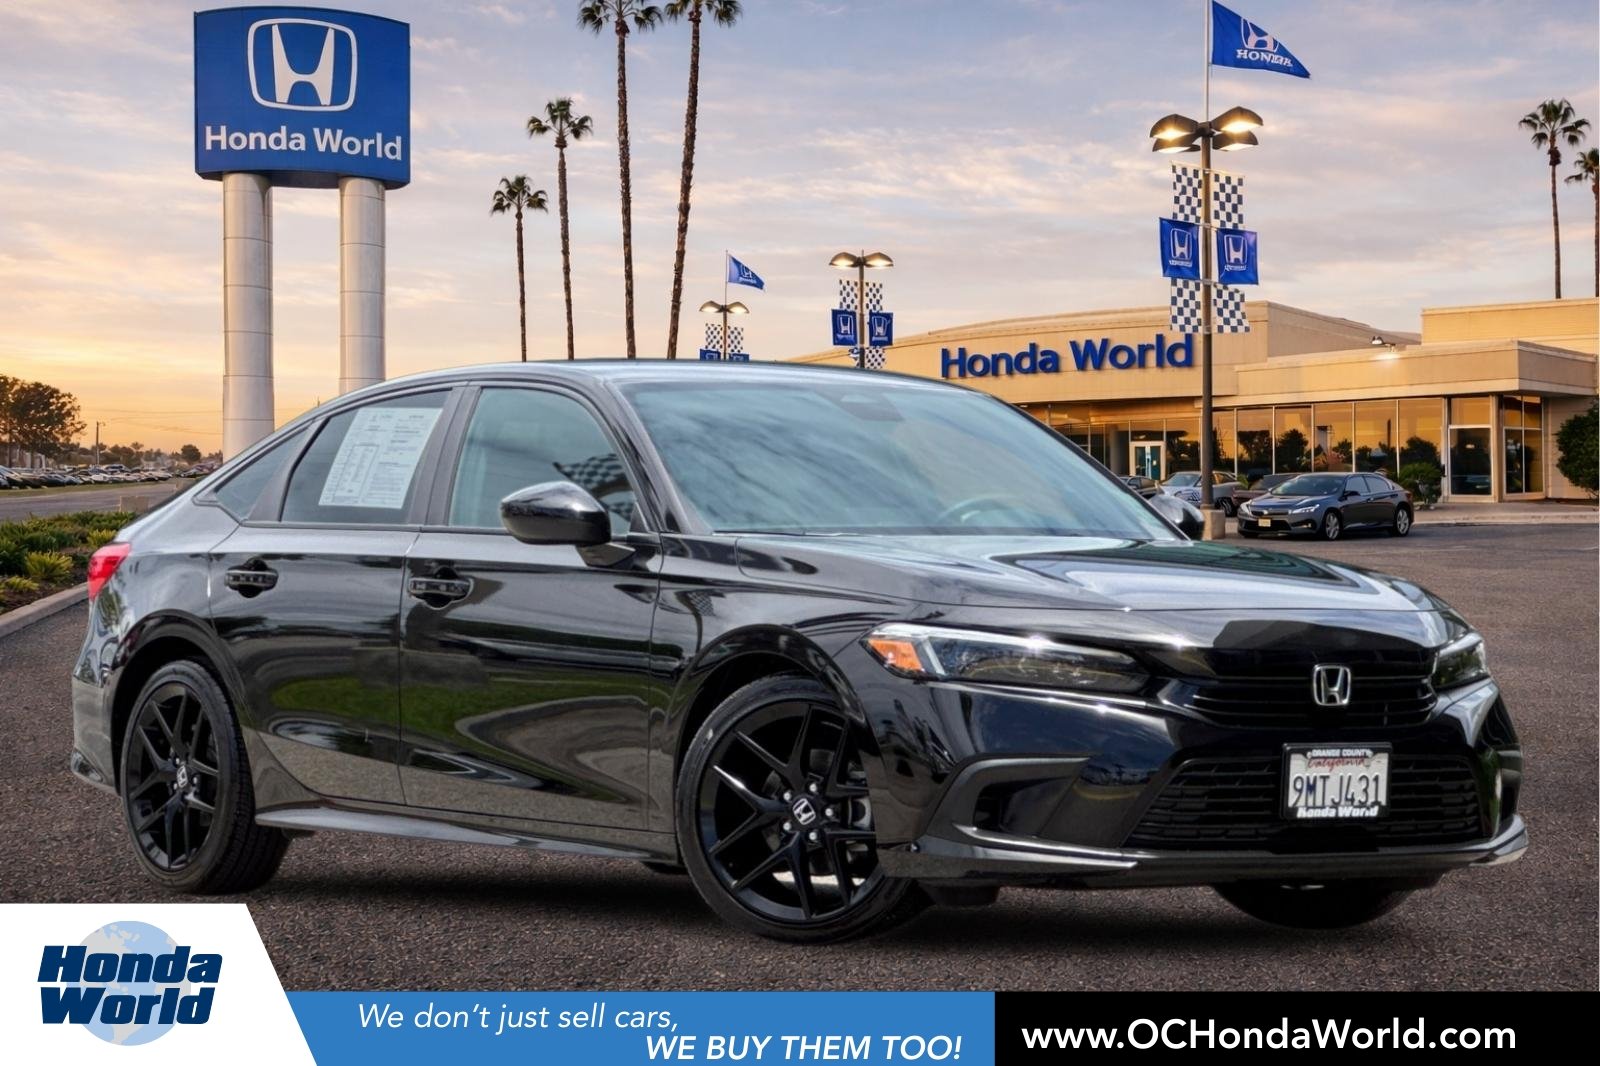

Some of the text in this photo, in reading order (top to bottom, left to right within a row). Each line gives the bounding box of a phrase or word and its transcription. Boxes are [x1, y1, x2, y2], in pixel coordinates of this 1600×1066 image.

[205, 125, 402, 160] Honda World
[941, 333, 1194, 378] Honda World
[1292, 774, 1382, 807] 9MTJ431
[1296, 805, 1379, 818] Honda World
